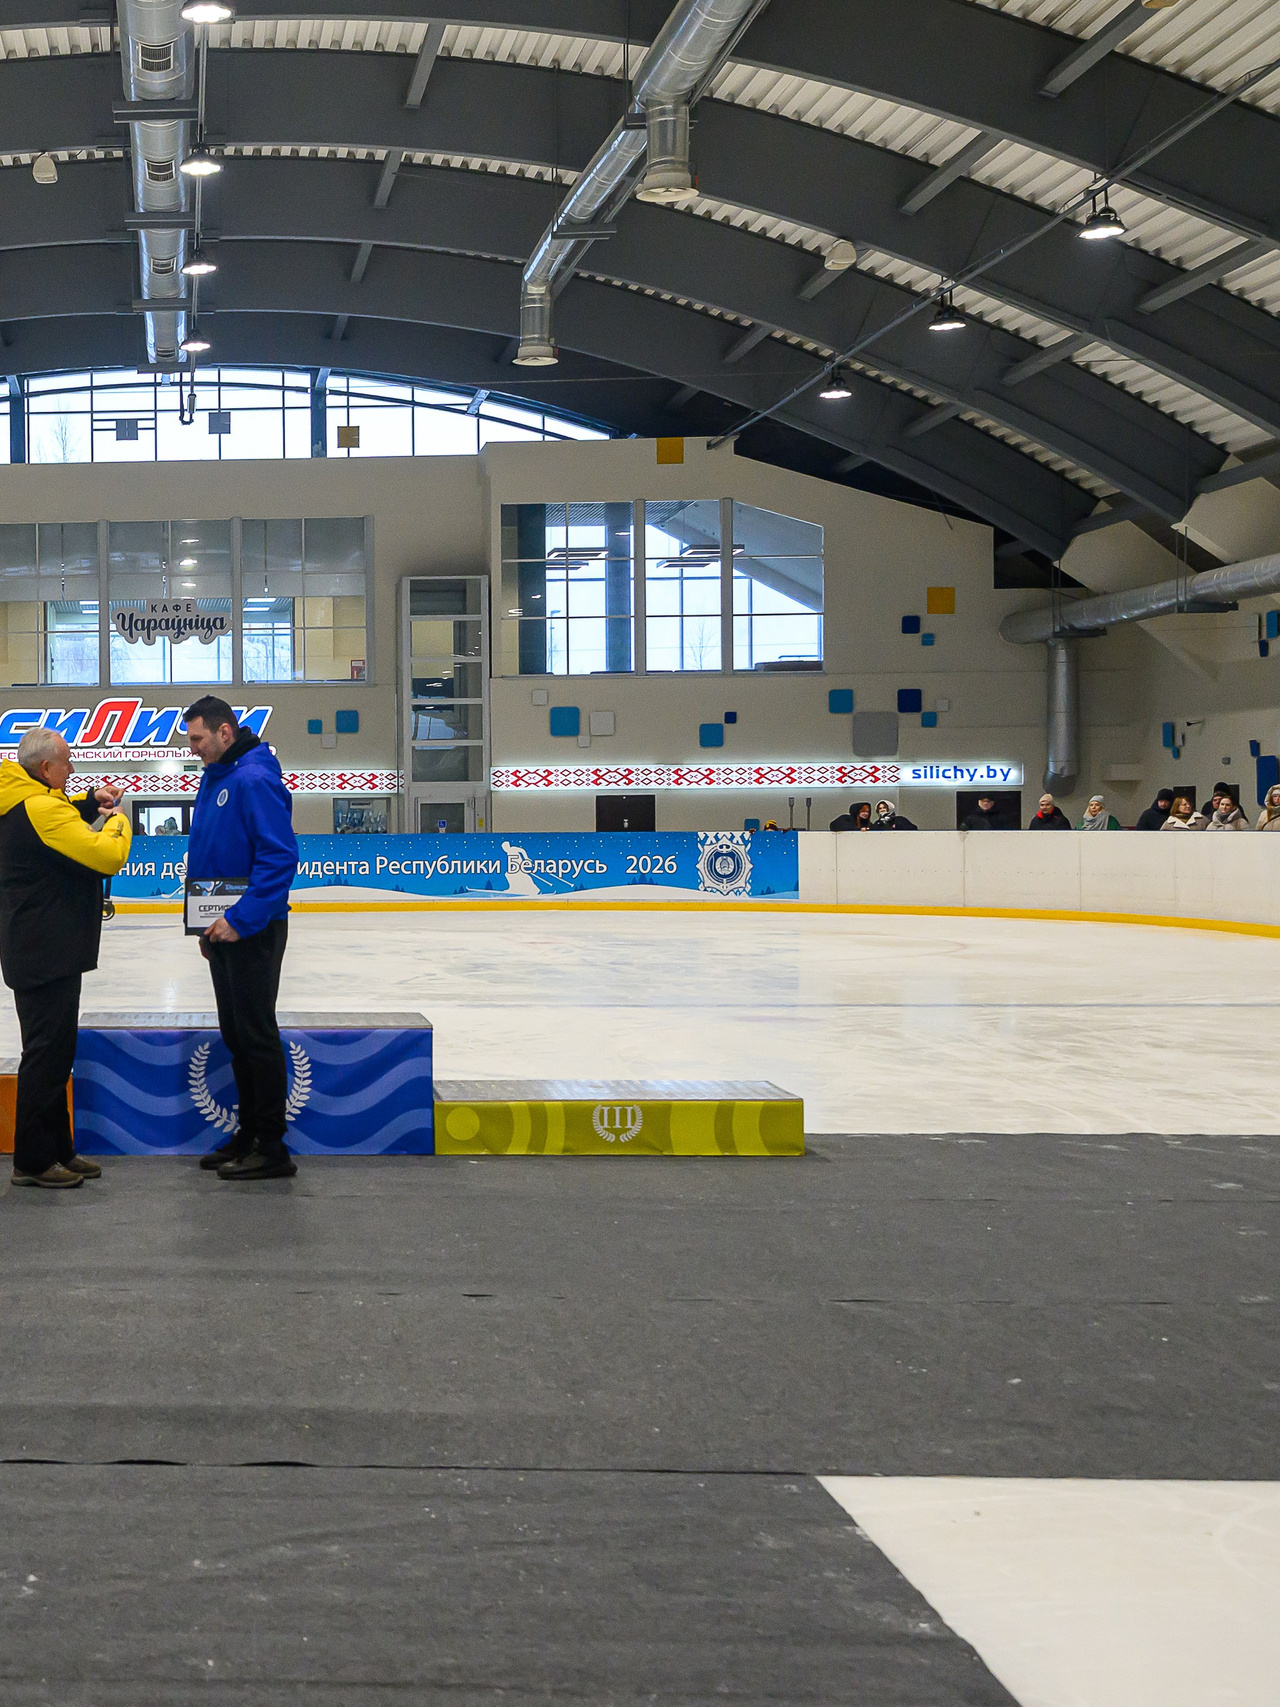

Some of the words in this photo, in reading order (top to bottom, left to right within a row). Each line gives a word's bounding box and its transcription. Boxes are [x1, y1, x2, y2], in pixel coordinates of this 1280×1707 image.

[151, 603, 192, 613] КАФЕ
[116, 612, 227, 640] Чараўніца
[912, 765, 1012, 782] silichy.by
[375, 855, 501, 879] Республики
[506, 854, 607, 879] Беларусь
[625, 855, 677, 874] 2026
[601, 1106, 634, 1128] III
